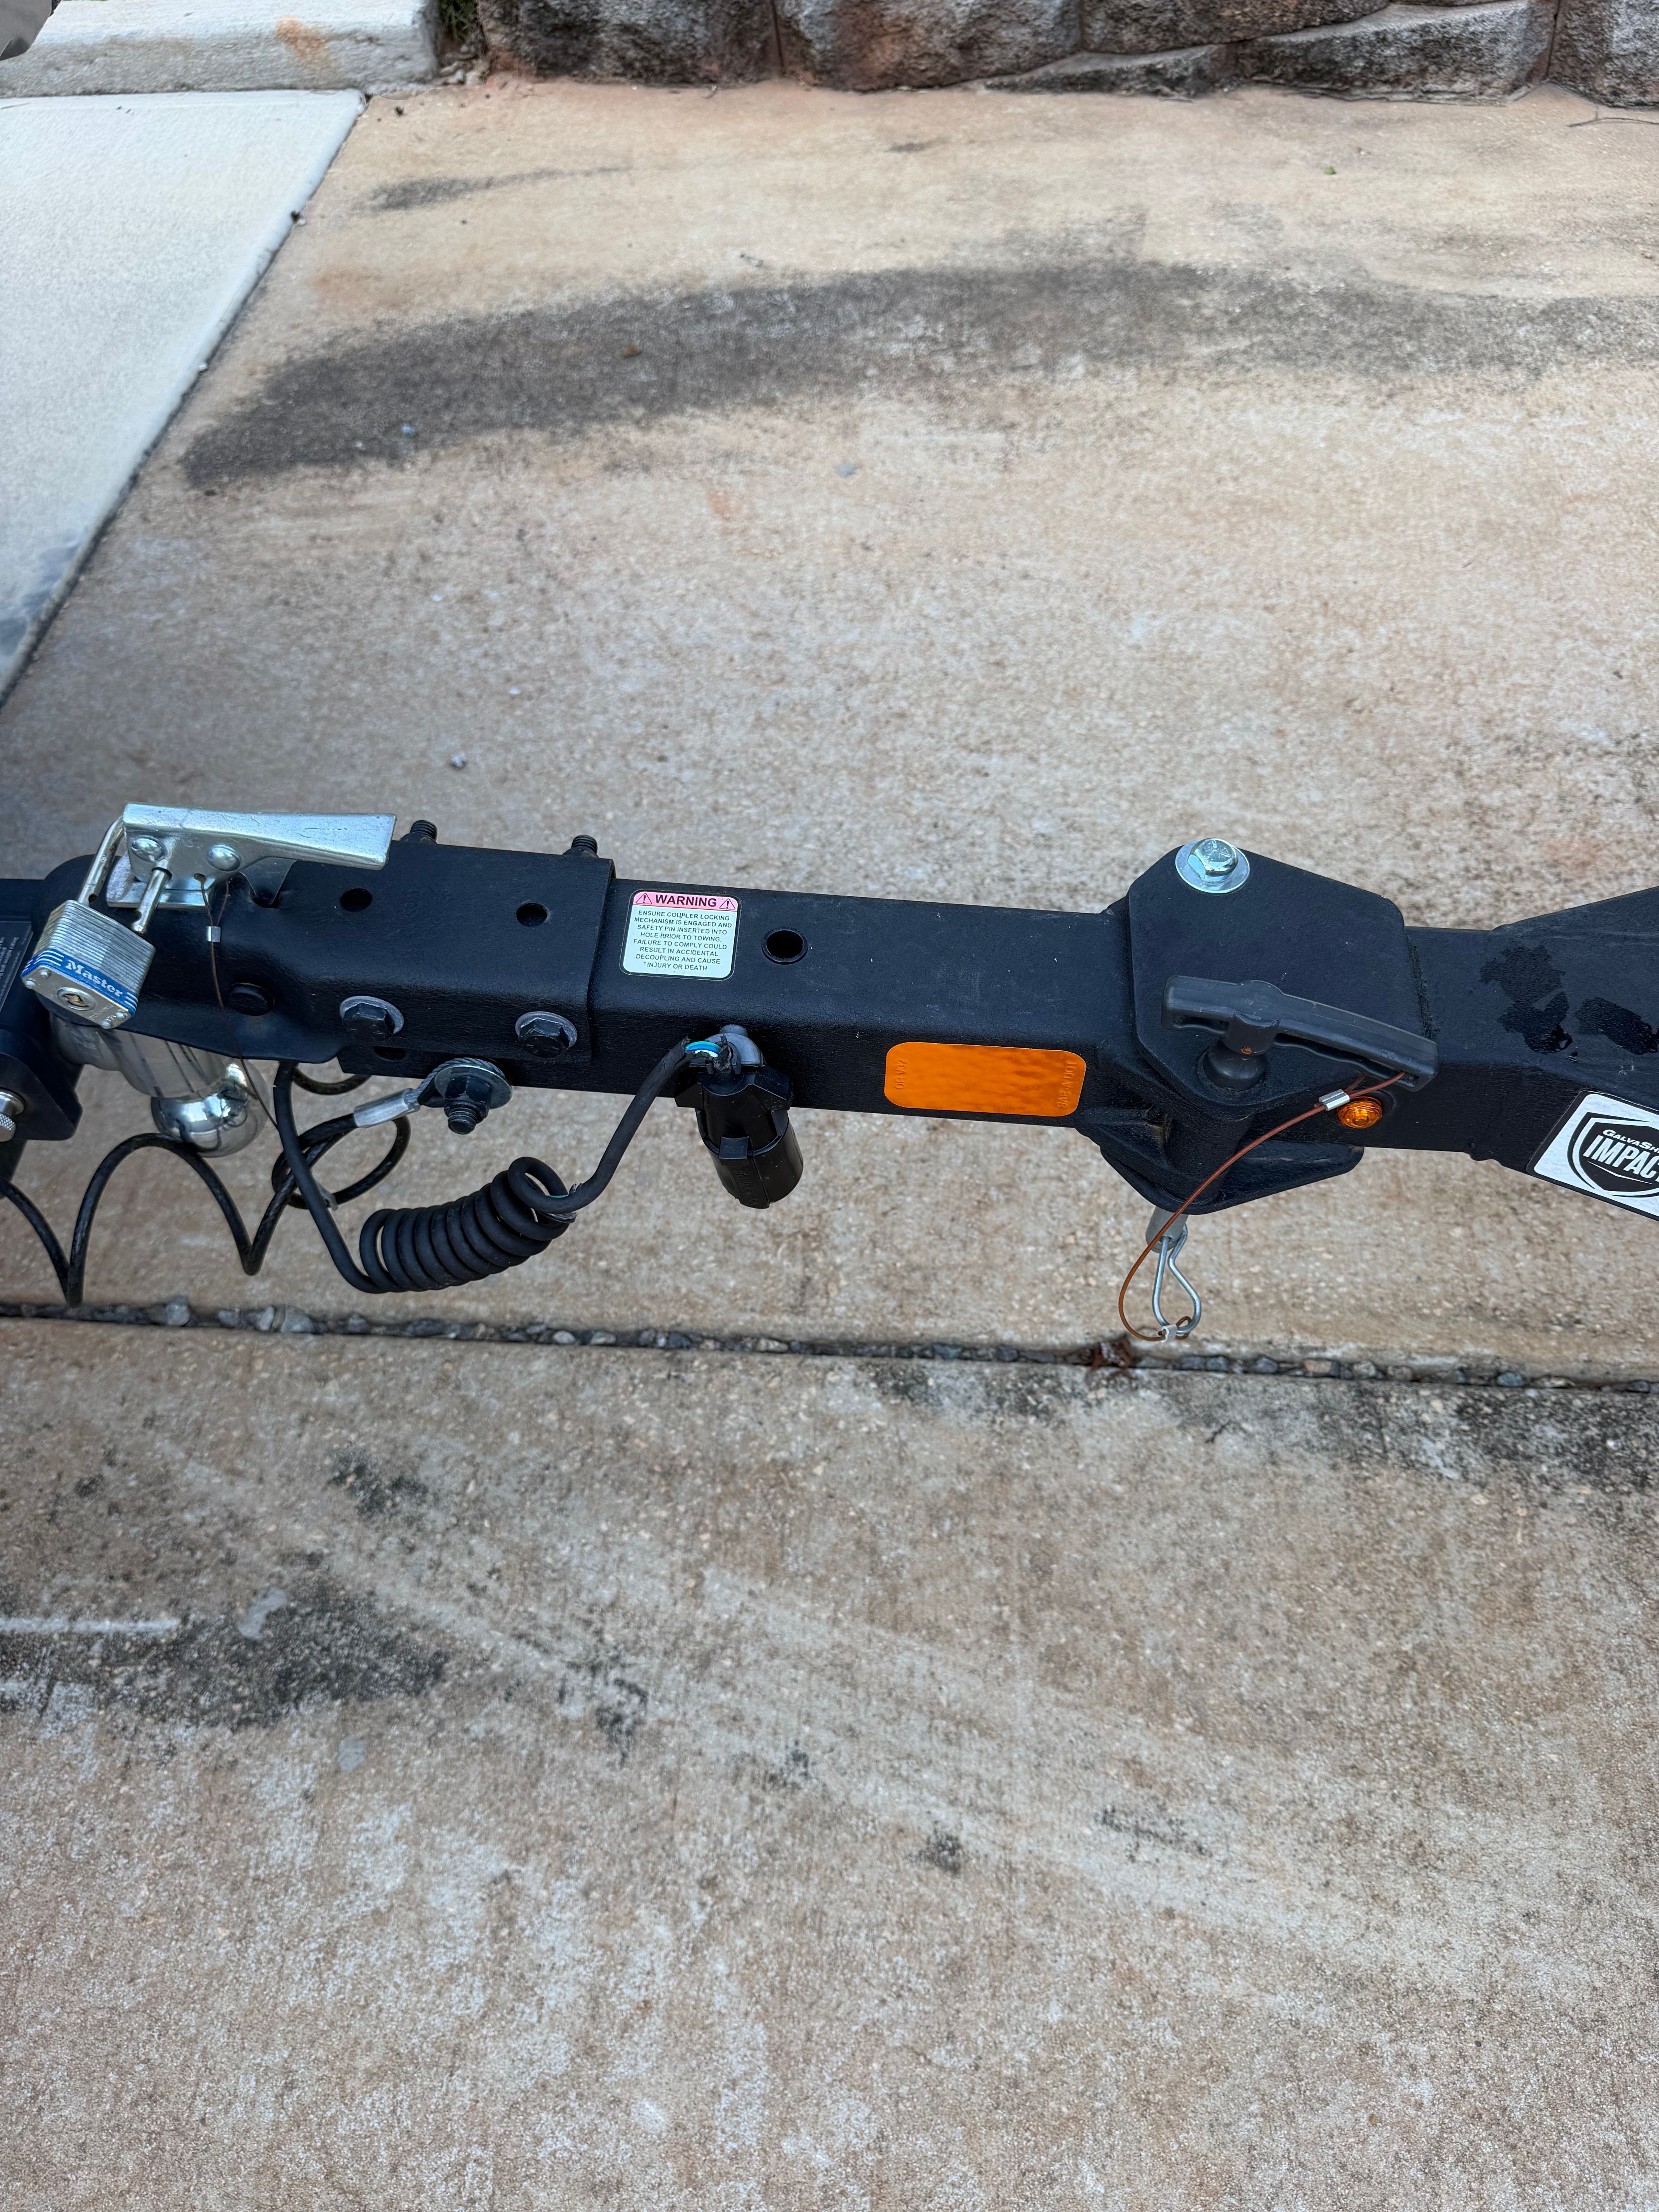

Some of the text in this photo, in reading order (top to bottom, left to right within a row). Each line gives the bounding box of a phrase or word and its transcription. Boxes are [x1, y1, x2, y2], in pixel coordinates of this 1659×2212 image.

[656, 894, 716, 907] WARNING
[66, 959, 124, 996] Master
[1583, 1135, 1659, 1182] IMPAC
